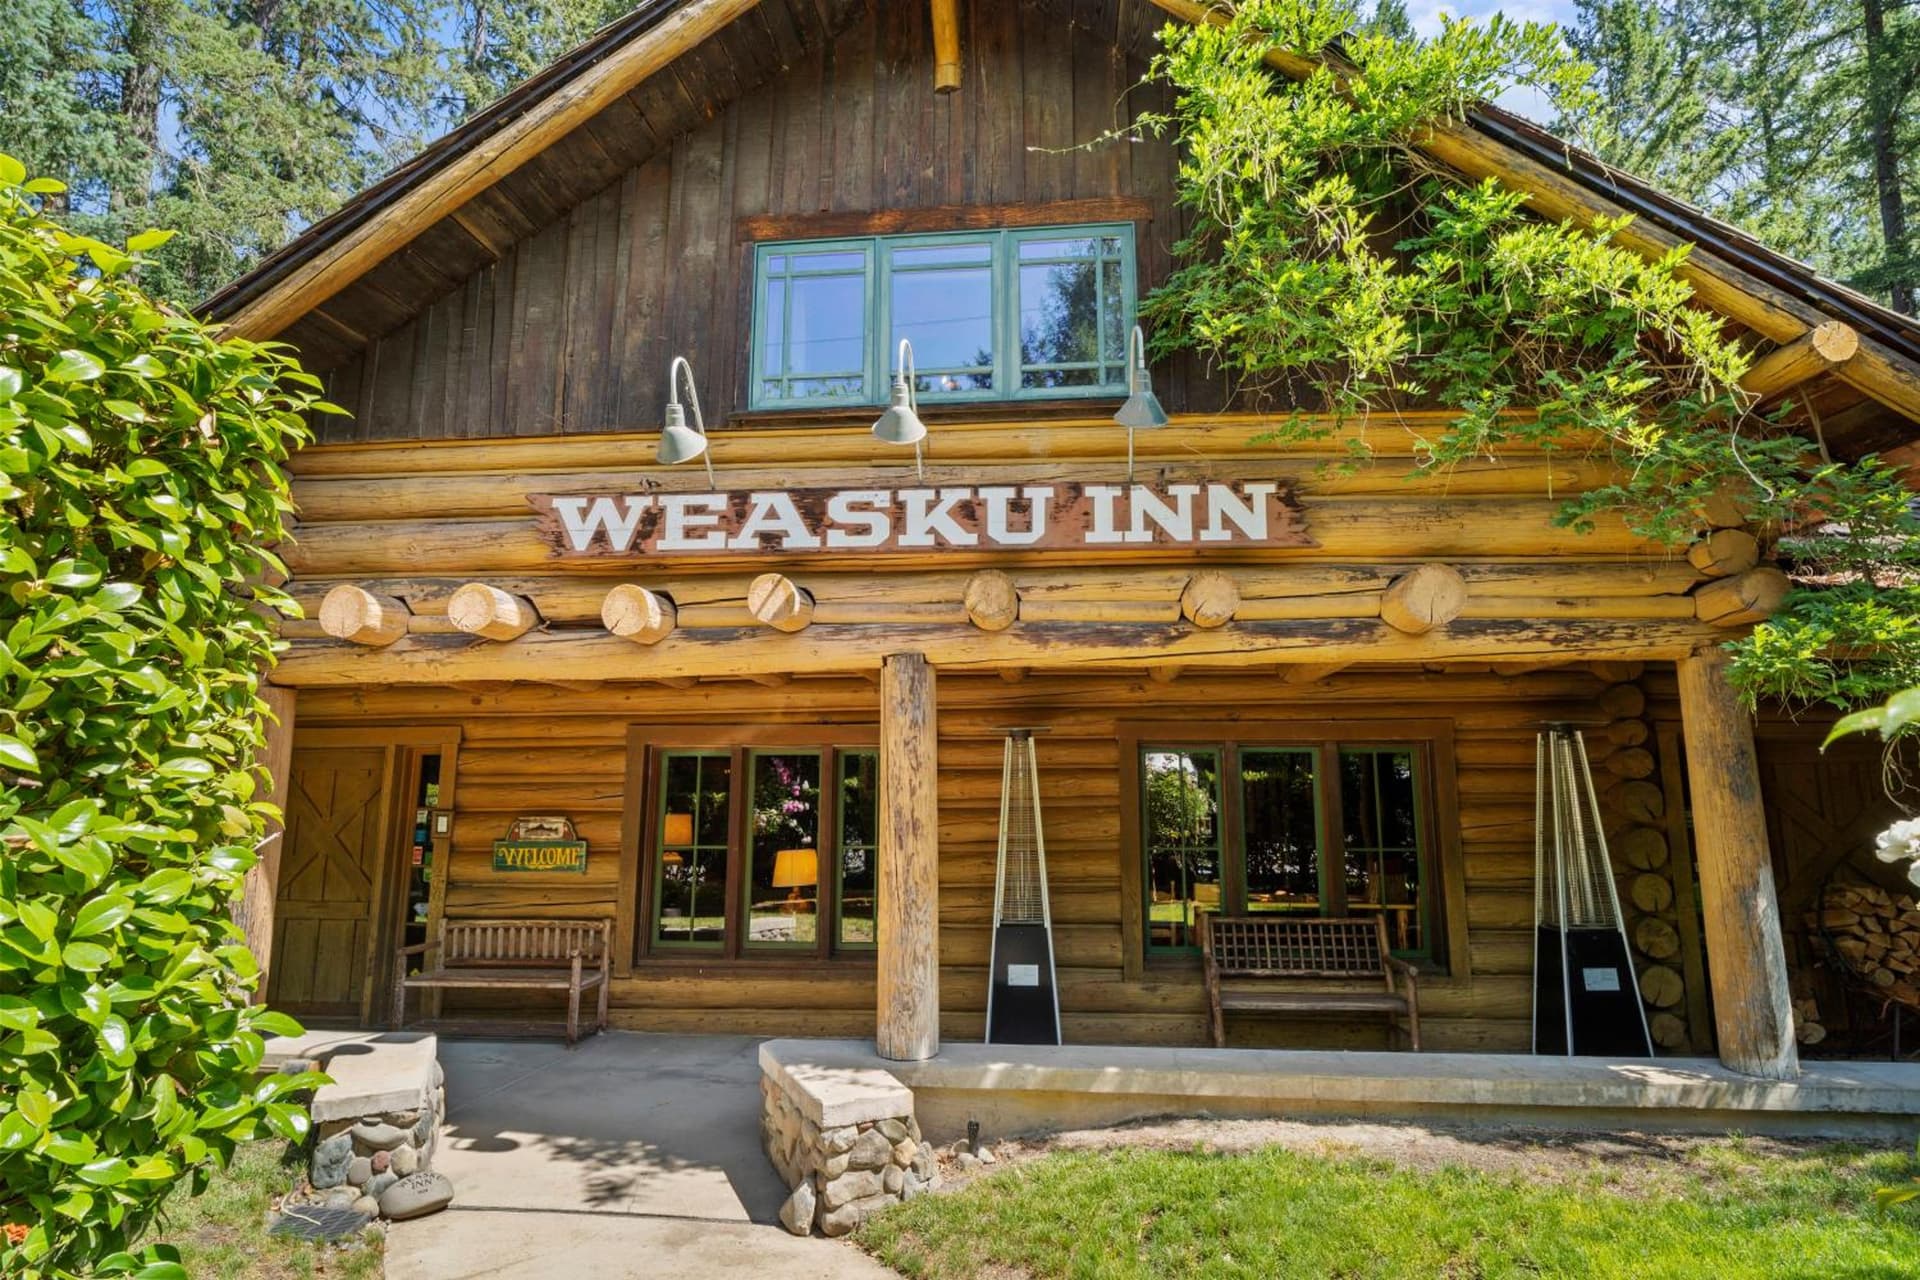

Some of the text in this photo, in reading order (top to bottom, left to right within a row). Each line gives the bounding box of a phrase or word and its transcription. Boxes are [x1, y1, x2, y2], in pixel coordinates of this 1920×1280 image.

[552, 484, 1278, 551] WEASKU INN
[499, 847, 581, 867] WELCOME
